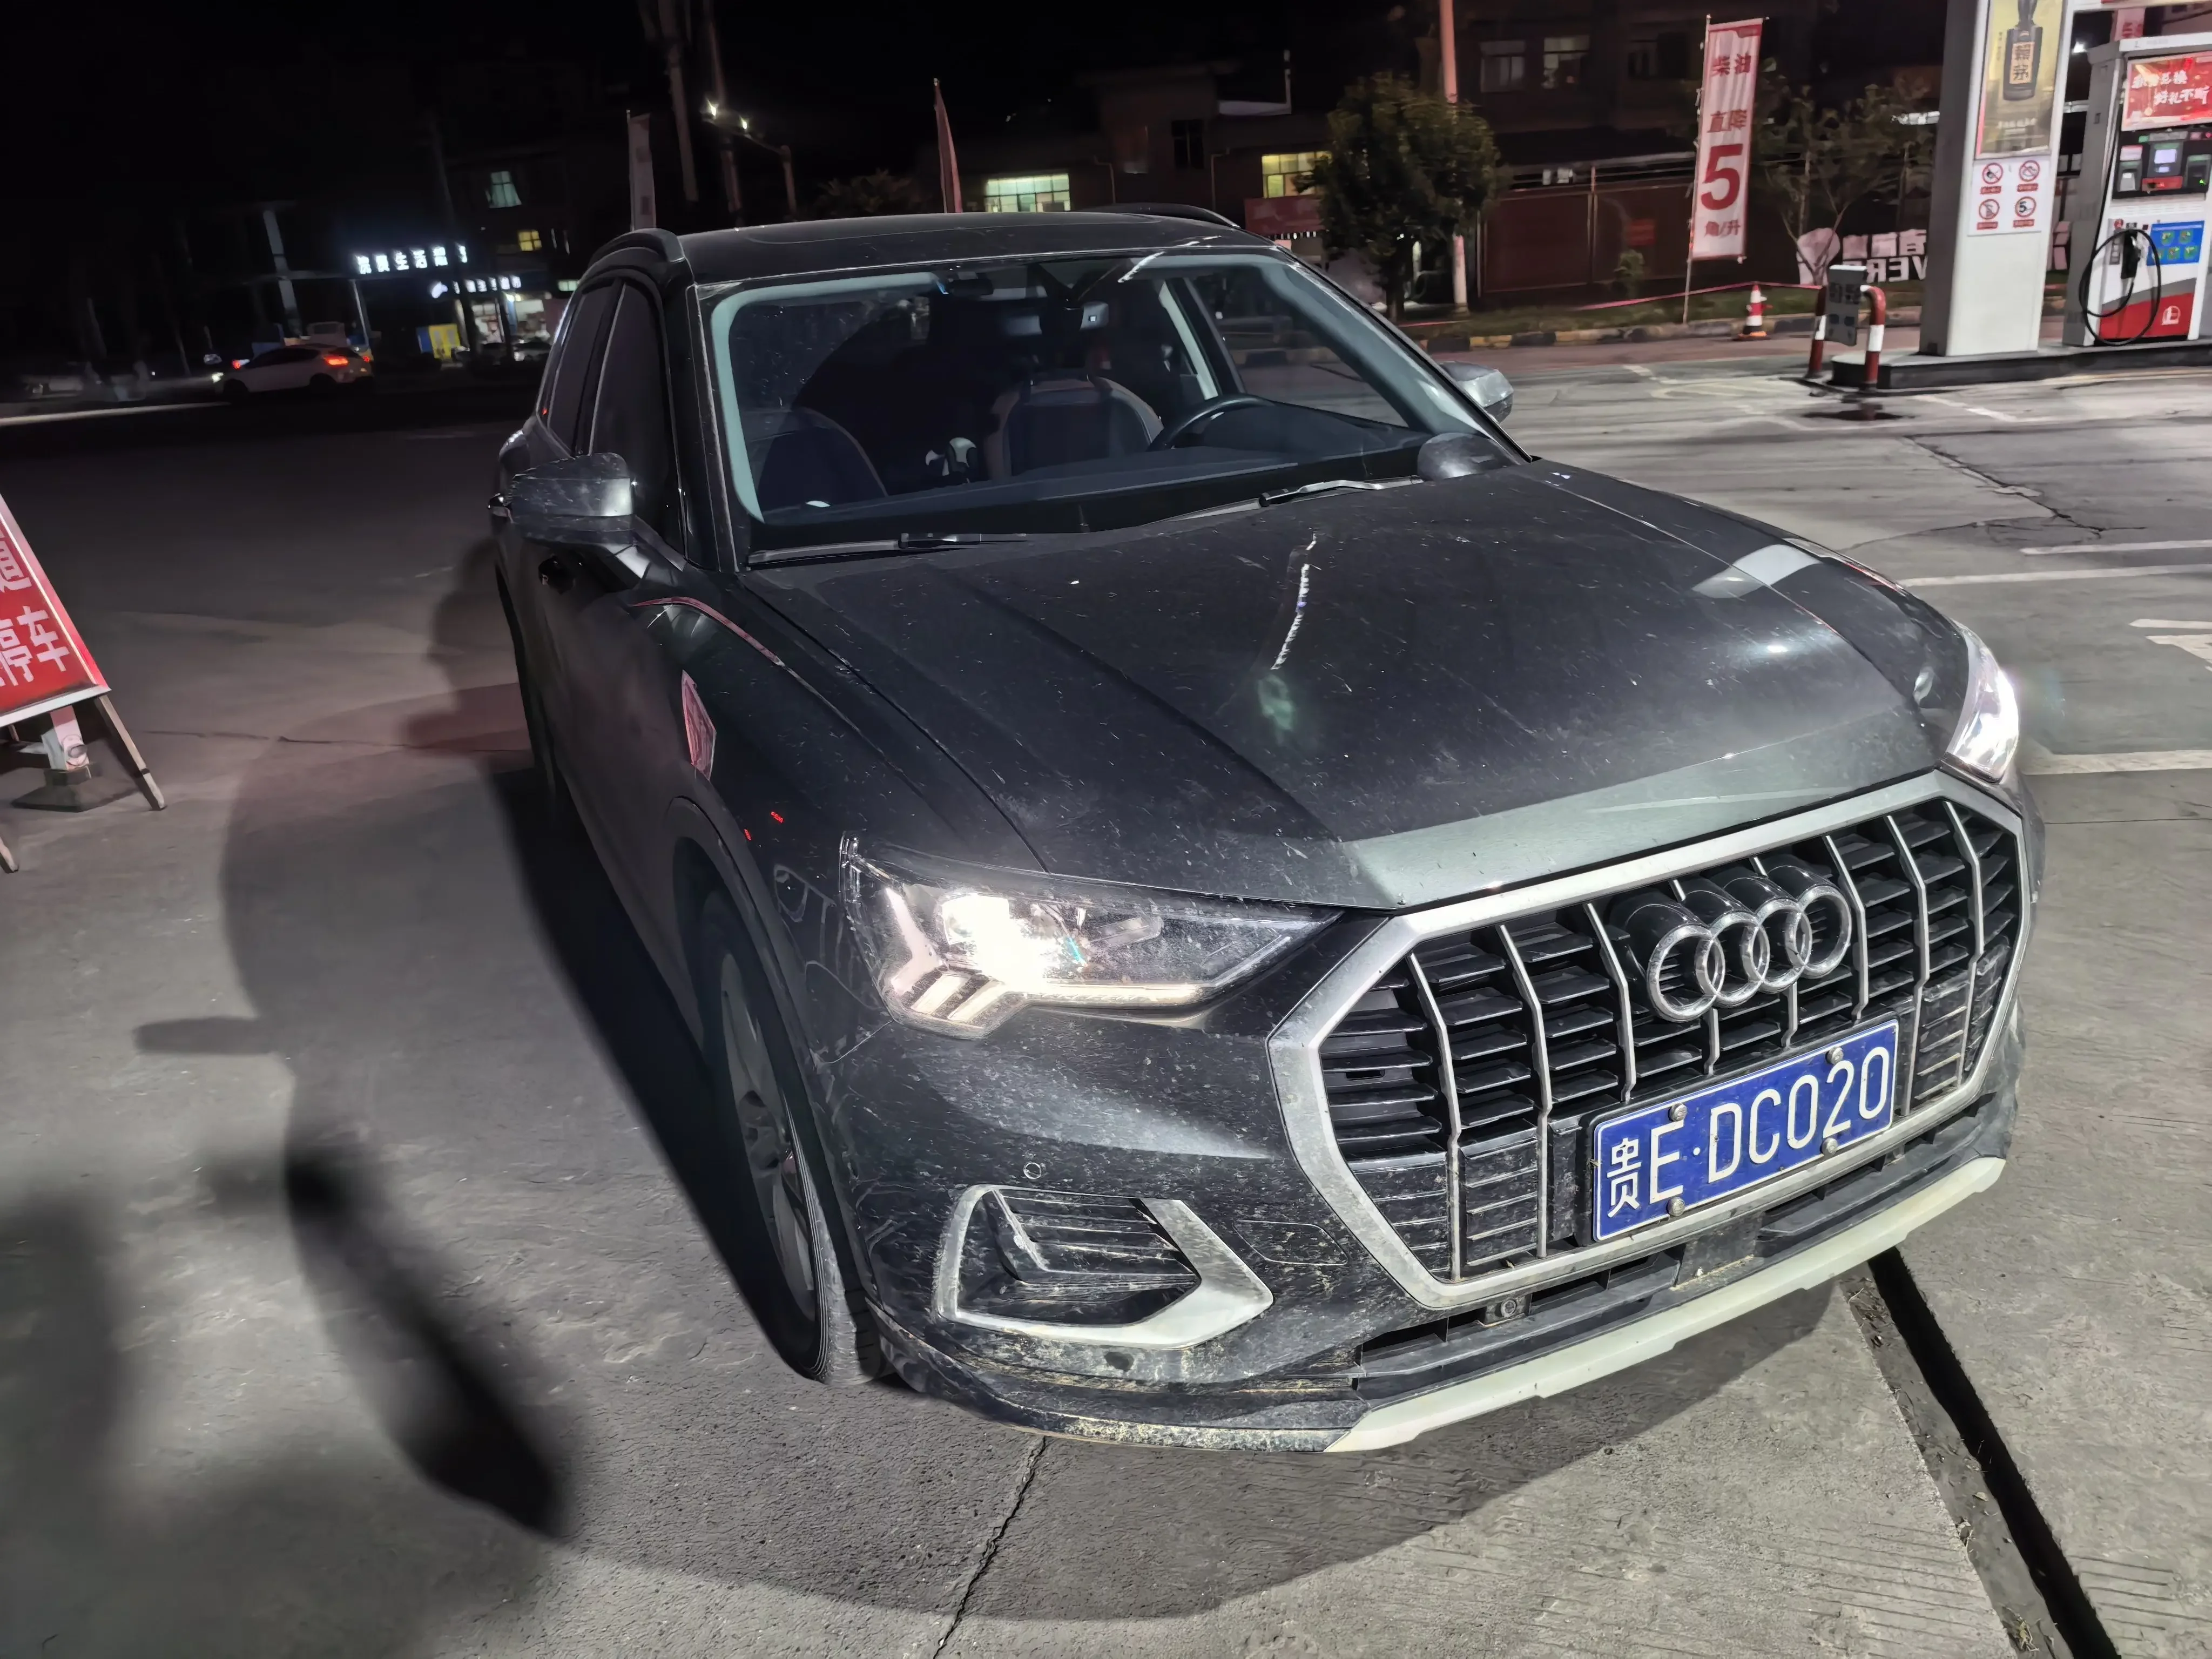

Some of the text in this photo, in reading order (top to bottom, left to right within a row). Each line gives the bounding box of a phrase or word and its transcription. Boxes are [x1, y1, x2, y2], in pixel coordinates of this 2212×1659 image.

[1710, 53, 1751, 77] 柴油
[2153, 85, 2210, 106] 好礼不断
[1701, 144, 1744, 211] 5
[0, 605, 70, 687] 停车
[1607, 1047, 1890, 1218] 贵E·DC020
